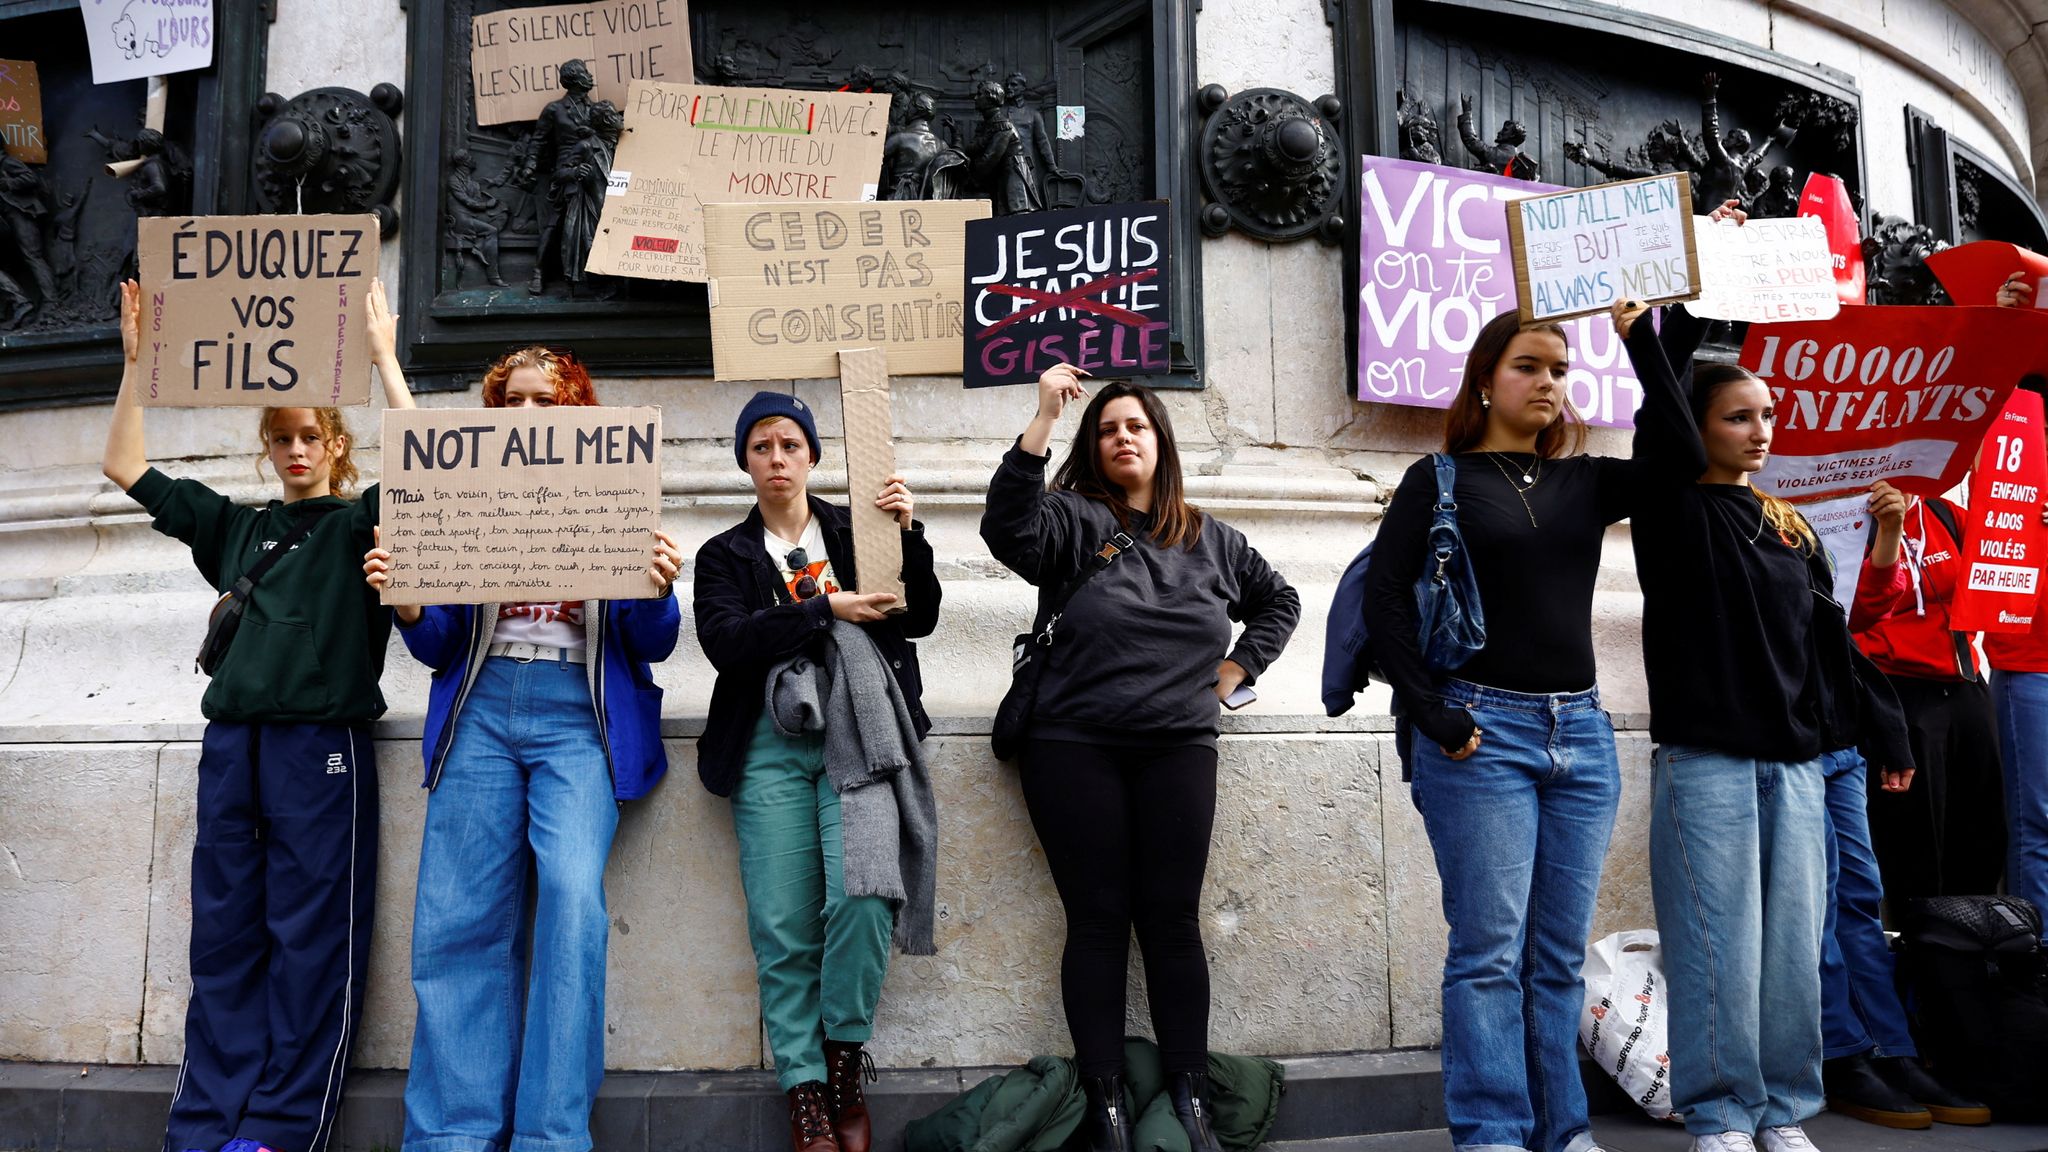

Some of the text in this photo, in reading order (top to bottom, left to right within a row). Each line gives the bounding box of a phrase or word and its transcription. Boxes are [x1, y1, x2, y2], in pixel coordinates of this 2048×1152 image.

[157, 16, 210, 50] L'OURS
[475, 22, 499, 47] LE
[479, 70, 506, 97] LE
[608, 45, 664, 84] TUE
[637, 89, 690, 122] POUR
[703, 95, 737, 125] EN
[818, 103, 878, 135] AVEC
[698, 131, 834, 166] LE MYTHE DU
[728, 172, 837, 199] MONSTRE
[668, 212, 681, 221] DE
[1577, 191, 1620, 225] ALL
[745, 208, 931, 251] CEDER
[1574, 223, 1628, 264] BUT
[173, 220, 363, 280] ÉDUQUEZ
[636, 238, 675, 252] VIOLEUR
[680, 242, 693, 254] EN
[971, 216, 1159, 284] JE SUIS
[1789, 249, 1827, 264] NOUS
[618, 262, 641, 271] POUR
[646, 264, 677, 274] VIOLER
[682, 266, 694, 275] SA
[763, 250, 934, 289] N'EST PAS
[1373, 250, 1505, 302] on te
[1777, 268, 1833, 285] PEUR
[1535, 257, 1688, 315] ALWAYS MENS
[1790, 292, 1832, 301] TOUTES
[231, 295, 295, 329] VOS
[980, 318, 1169, 376] GISÈLE
[1755, 336, 1955, 386] 160000
[1367, 357, 1450, 400] on
[403, 422, 655, 471] NOT ALL MEN
[1995, 435, 2024, 473] 18
[1776, 460, 1913, 489] VIOLENCES SEXUELLES
[1816, 453, 1893, 472] VICTIMES DE
[386, 488, 424, 504] Mais
[433, 487, 452, 500] ton
[497, 488, 518, 500] ton
[573, 486, 591, 497] ton
[1990, 481, 2038, 504] ENFANTS
[391, 509, 412, 520] ton
[454, 508, 474, 518] ton
[478, 507, 522, 518] meilleur
[558, 506, 580, 515] ton
[585, 506, 609, 514] oncle
[1985, 510, 2024, 531] & ADOS
[391, 526, 416, 537] ton
[420, 528, 446, 536] coach
[489, 525, 508, 535] ton
[512, 527, 553, 539] rappeur
[597, 524, 616, 534] ton
[388, 544, 409, 553] ton
[462, 542, 481, 552] ton
[527, 544, 547, 553] ton
[589, 544, 601, 553] de
[390, 559, 413, 570] ton
[452, 559, 474, 570] ton
[529, 561, 550, 571] ton
[588, 562, 607, 571] ton
[1972, 568, 2032, 589] PAR HEURE
[387, 577, 410, 588] ton
[479, 577, 500, 588] ton
[504, 577, 552, 588] ministre
[326, 766, 347, 774] 232
[1616, 1025, 1643, 1073] GRAPHIGRO
